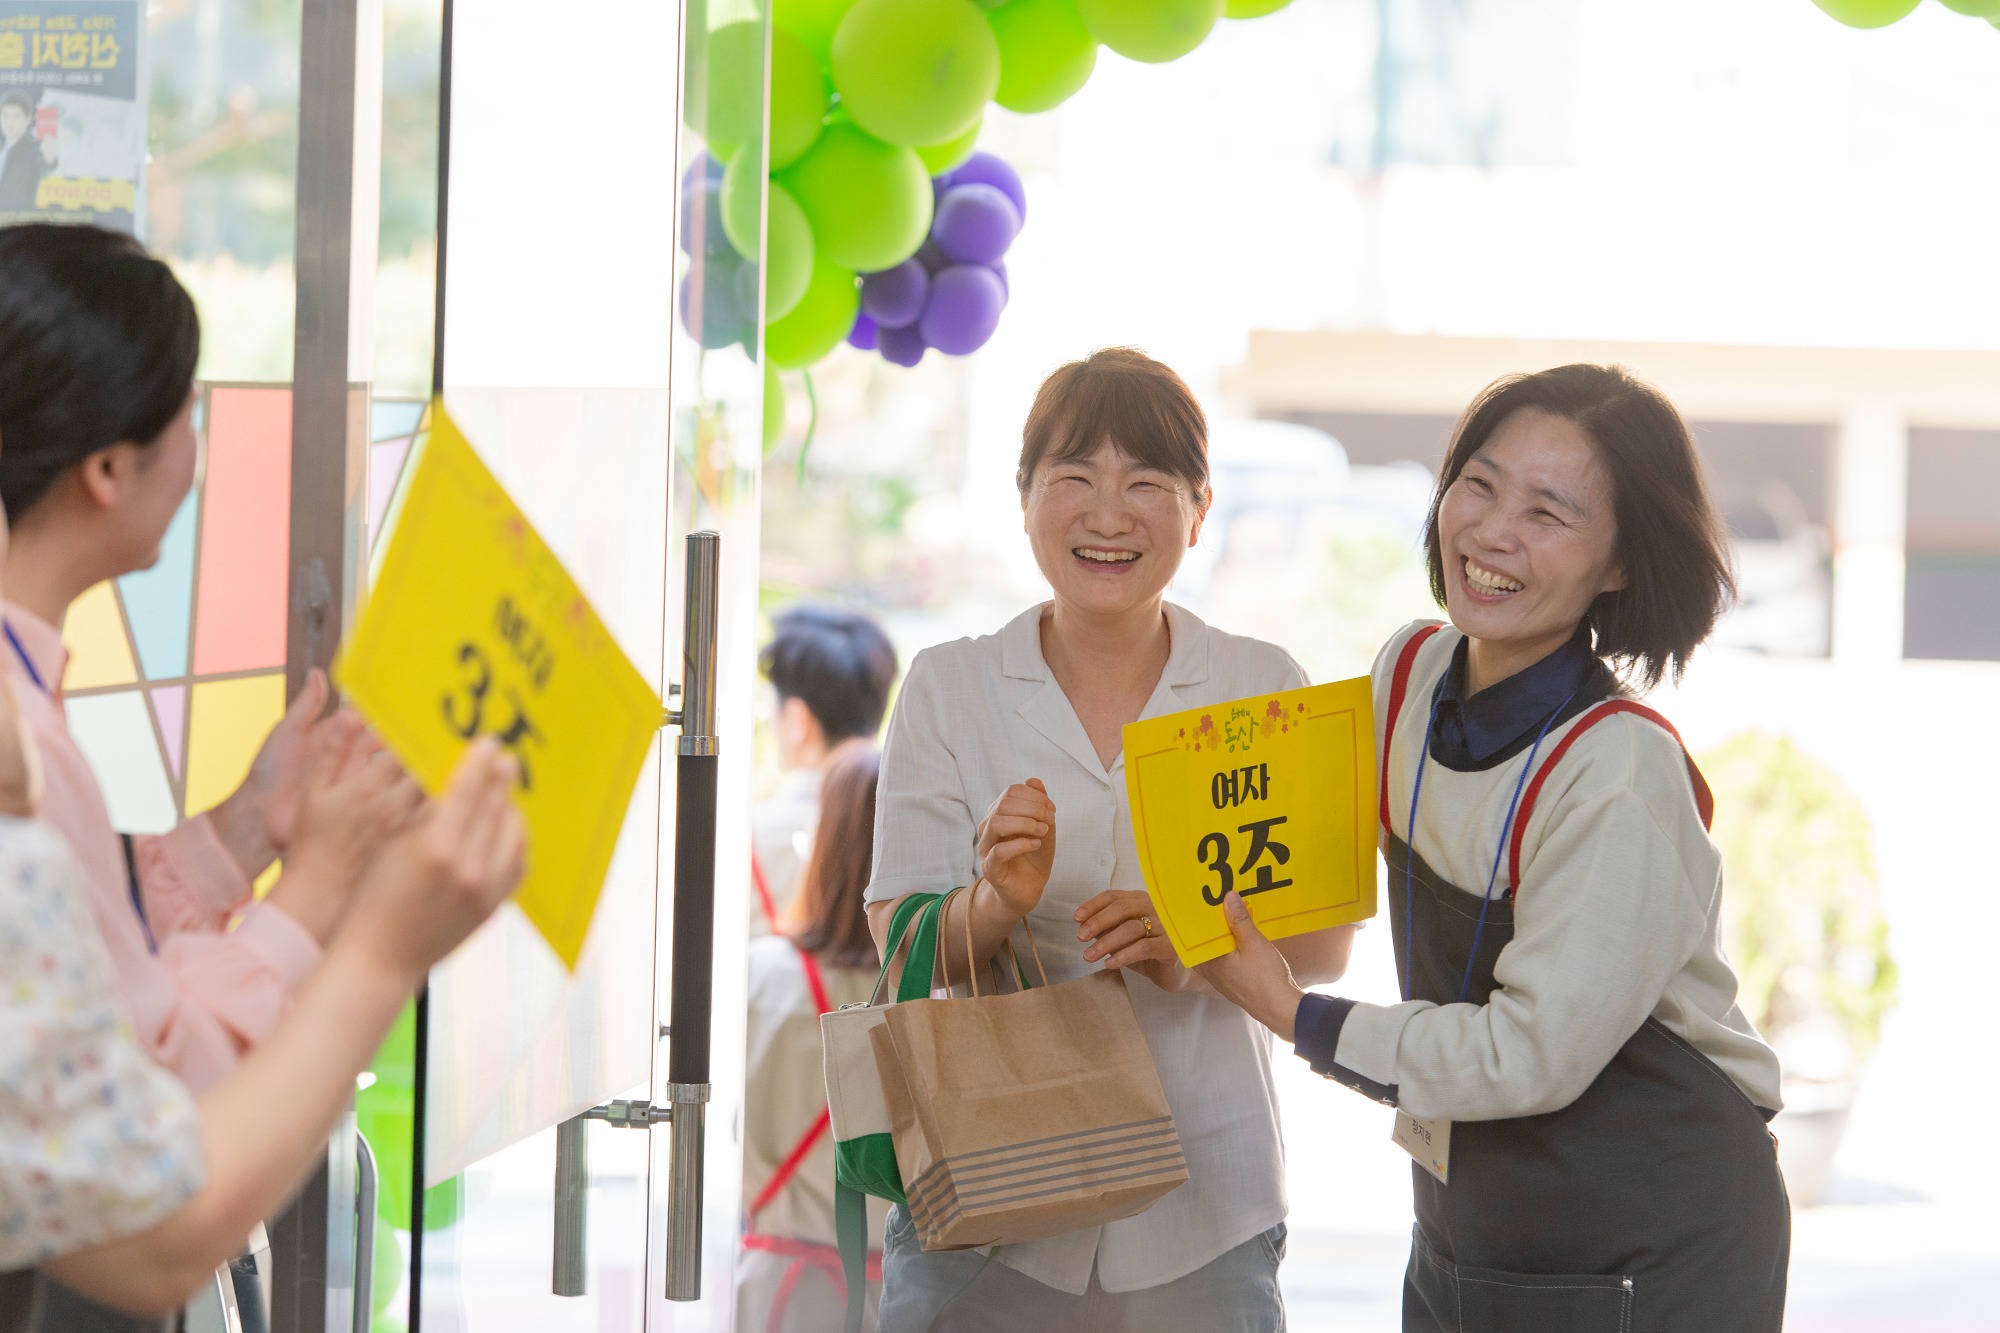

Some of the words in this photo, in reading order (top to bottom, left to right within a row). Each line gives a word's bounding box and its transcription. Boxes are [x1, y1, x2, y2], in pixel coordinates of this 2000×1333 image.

[1224, 716, 1259, 753] 동산
[1211, 763, 1271, 809] 여자
[1197, 816, 1293, 906] 3조
